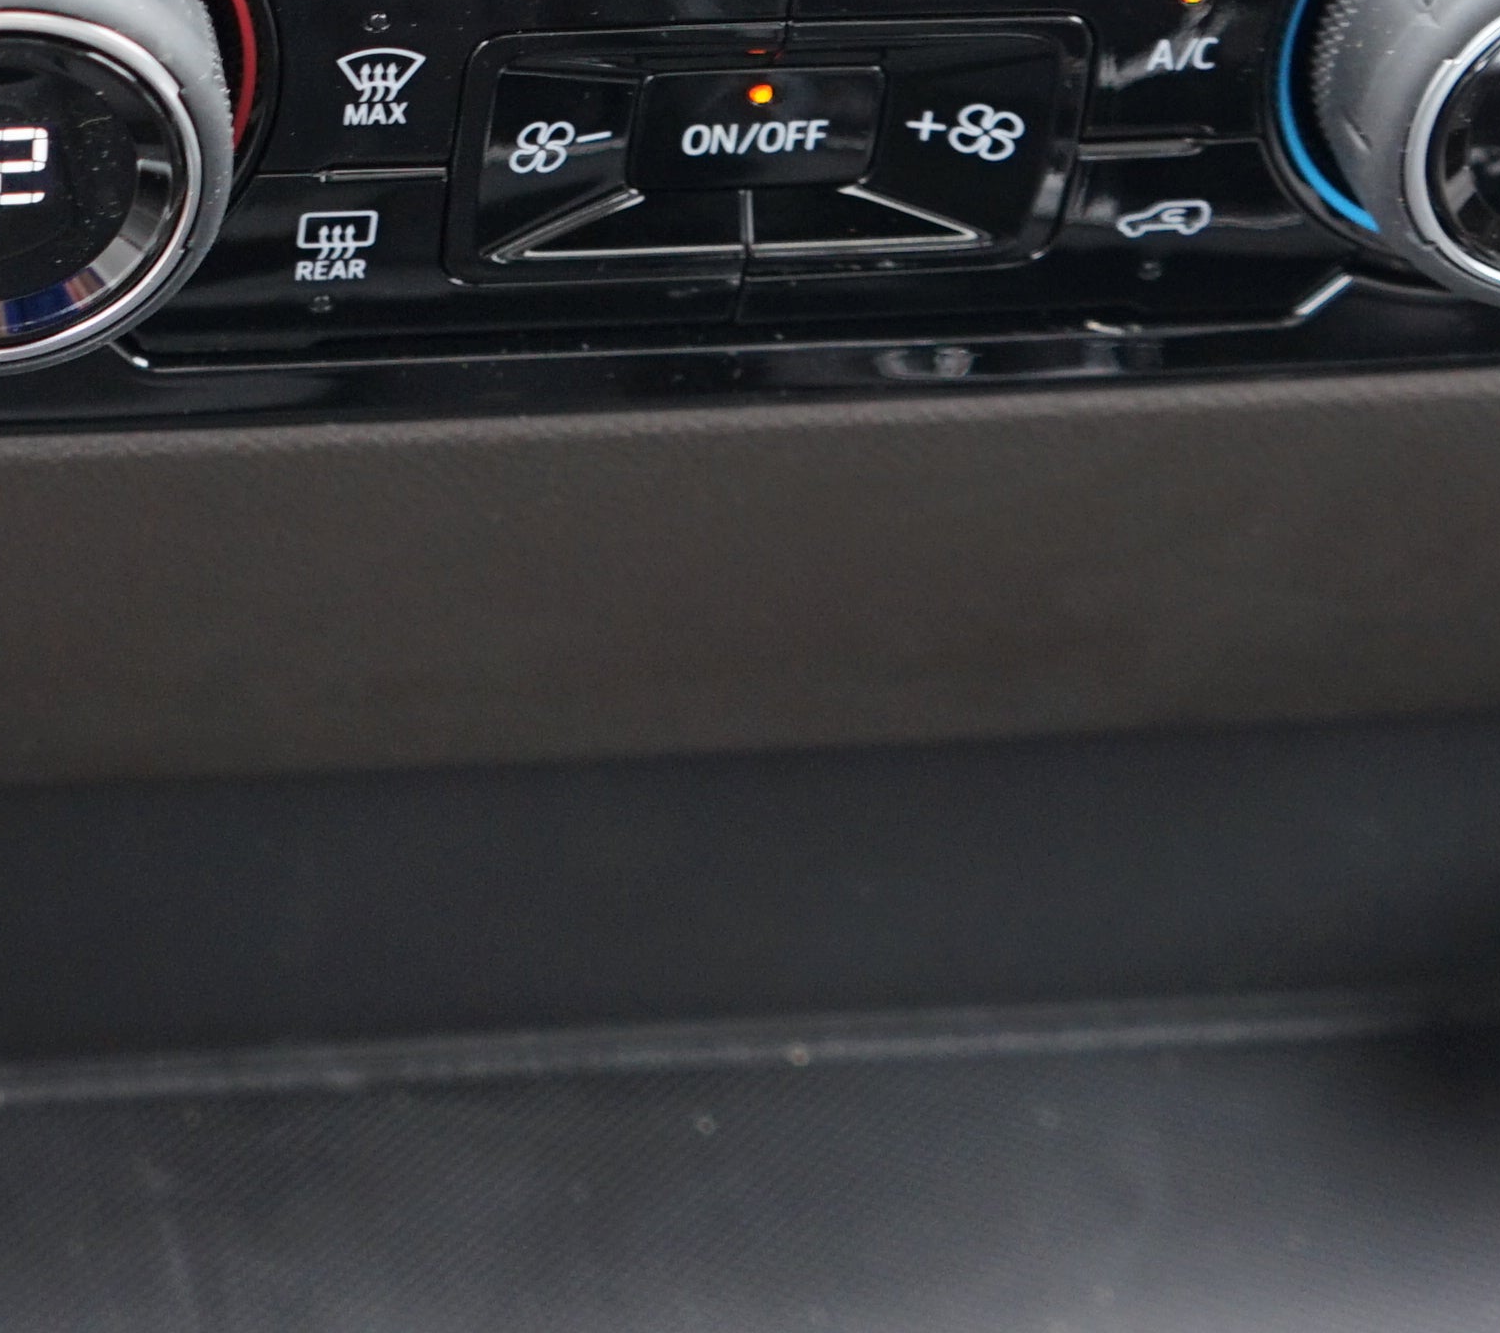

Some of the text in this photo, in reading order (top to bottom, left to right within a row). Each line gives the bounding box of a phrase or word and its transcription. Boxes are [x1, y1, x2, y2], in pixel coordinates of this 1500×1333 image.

[1147, 37, 1219, 71] A/C
[343, 102, 408, 126] MAX
[681, 118, 829, 156] ON/OFF
[294, 259, 367, 281] REAR
